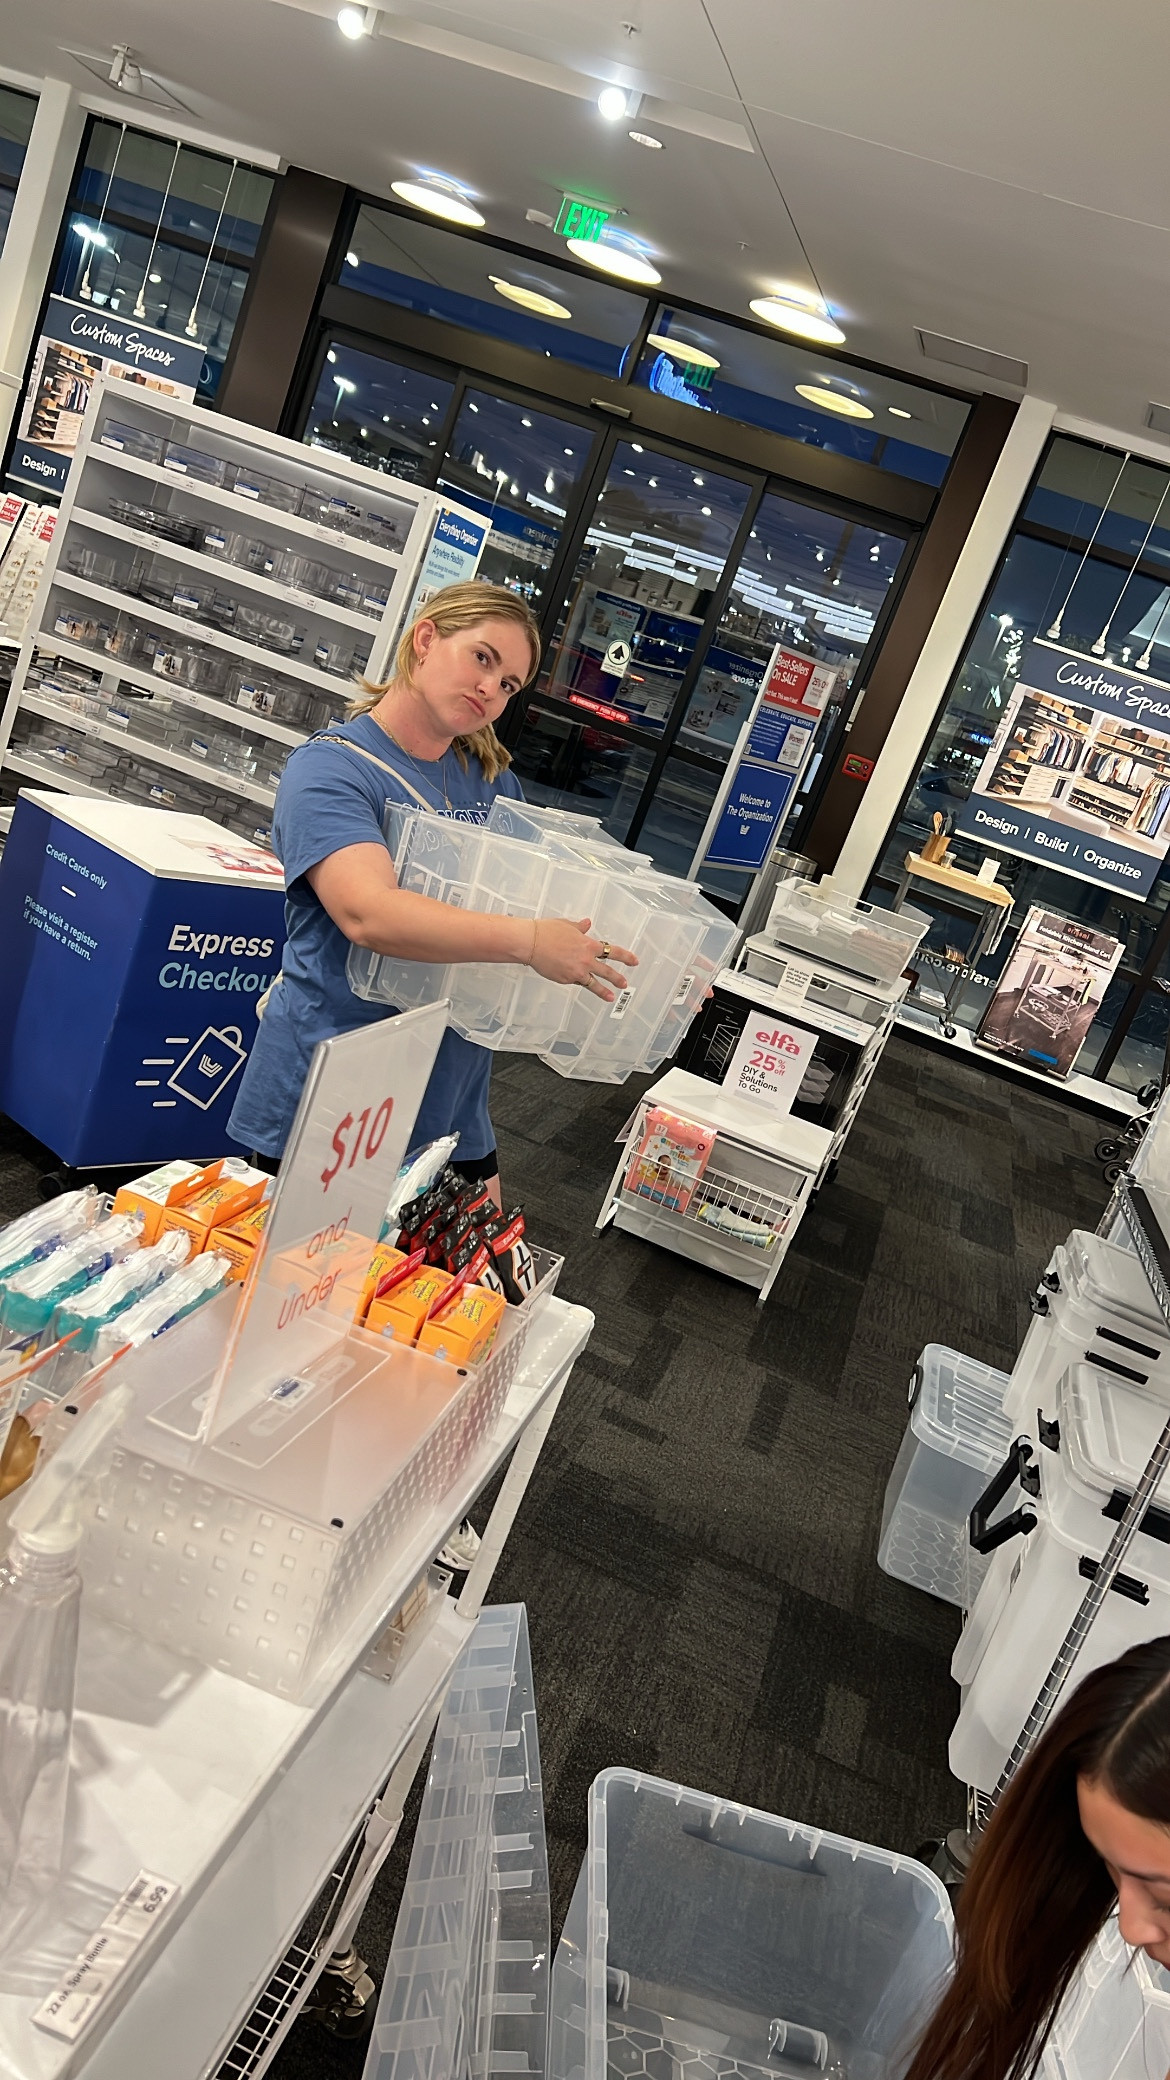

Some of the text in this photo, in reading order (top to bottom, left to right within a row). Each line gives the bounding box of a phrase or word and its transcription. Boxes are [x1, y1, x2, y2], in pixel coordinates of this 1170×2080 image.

[563, 202, 609, 243] EXIT
[70, 313, 175, 367] Custom Spaces
[22, 455, 56, 477] Design
[439, 519, 461, 541] Everything
[460, 528, 479, 547] Organizer
[771, 668, 798, 686] On SALE
[776, 654, 810, 677] Best-Sellers
[1056, 660, 1170, 721] Custom Spac
[726, 805, 773, 823] The Organization
[738, 793, 771, 808] Welcome to
[974, 809, 1143, 880] Design Build Organize
[46, 844, 107, 890] Credit Cards only
[23, 909, 92, 961] if you have a return.
[24, 895, 98, 950] Please visit a register
[1067, 927, 1090, 940] origami
[168, 925, 274, 959] Express
[1063, 933, 1084, 948] Kitchen
[1083, 943, 1101, 955] Island
[1100, 949, 1112, 960] Cart
[159, 962, 276, 993] Checkou
[755, 1030, 800, 1055] elfa
[740, 1073, 778, 1093] Solutions
[743, 1065, 766, 1080] DIY &
[774, 1069, 786, 1077] off
[738, 1080, 761, 1094] To Go
[321, 1097, 394, 1193] $10
[306, 1206, 353, 1259] and
[143, 1886, 168, 1914] 6.99
[47, 2002, 62, 2016] 22
[67, 1962, 91, 1988] Spray
[86, 1937, 108, 1963] Bottle
